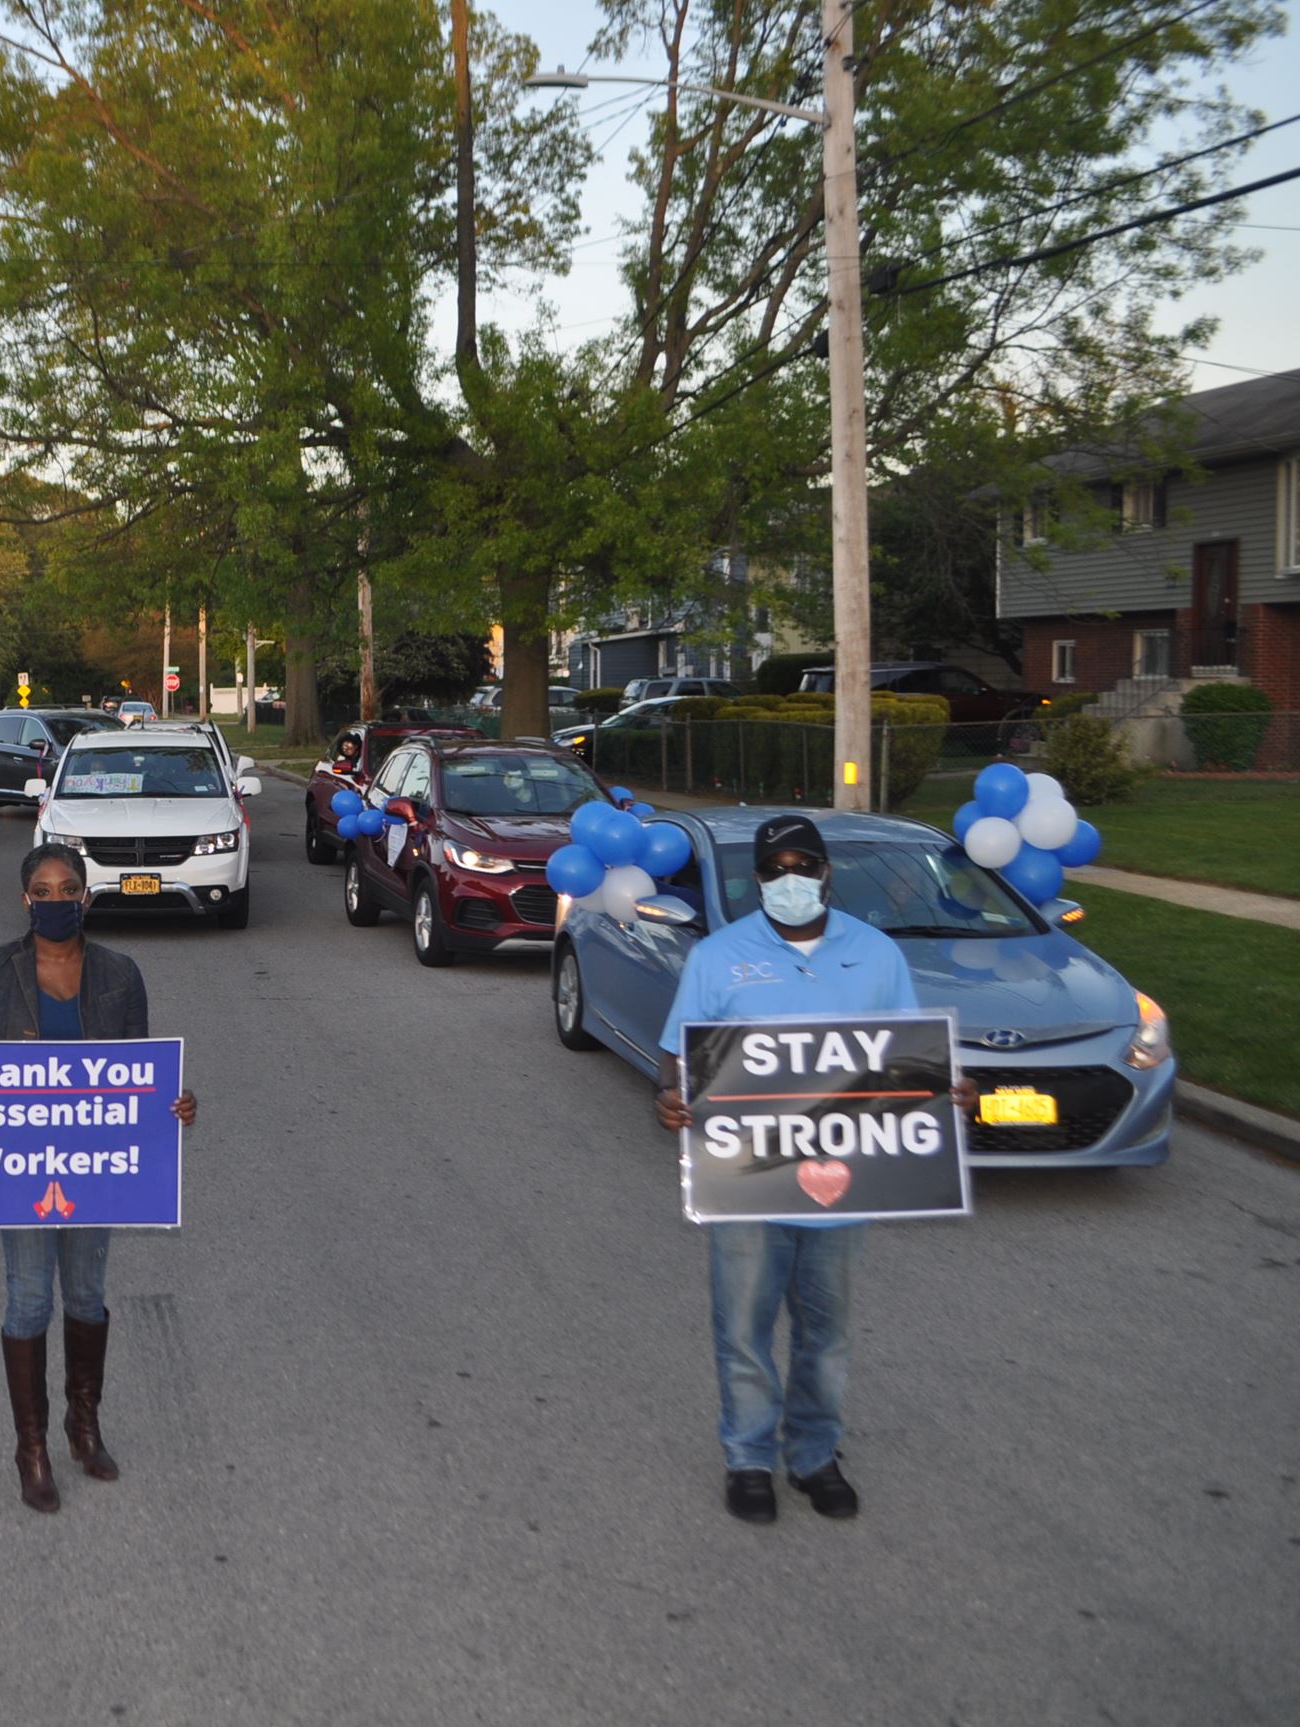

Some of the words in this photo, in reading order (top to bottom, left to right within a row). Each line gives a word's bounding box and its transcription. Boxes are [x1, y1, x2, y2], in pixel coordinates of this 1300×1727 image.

[81, 1057, 155, 1087] You
[741, 1028, 894, 1076] STAY
[703, 1111, 942, 1159] STRONG
